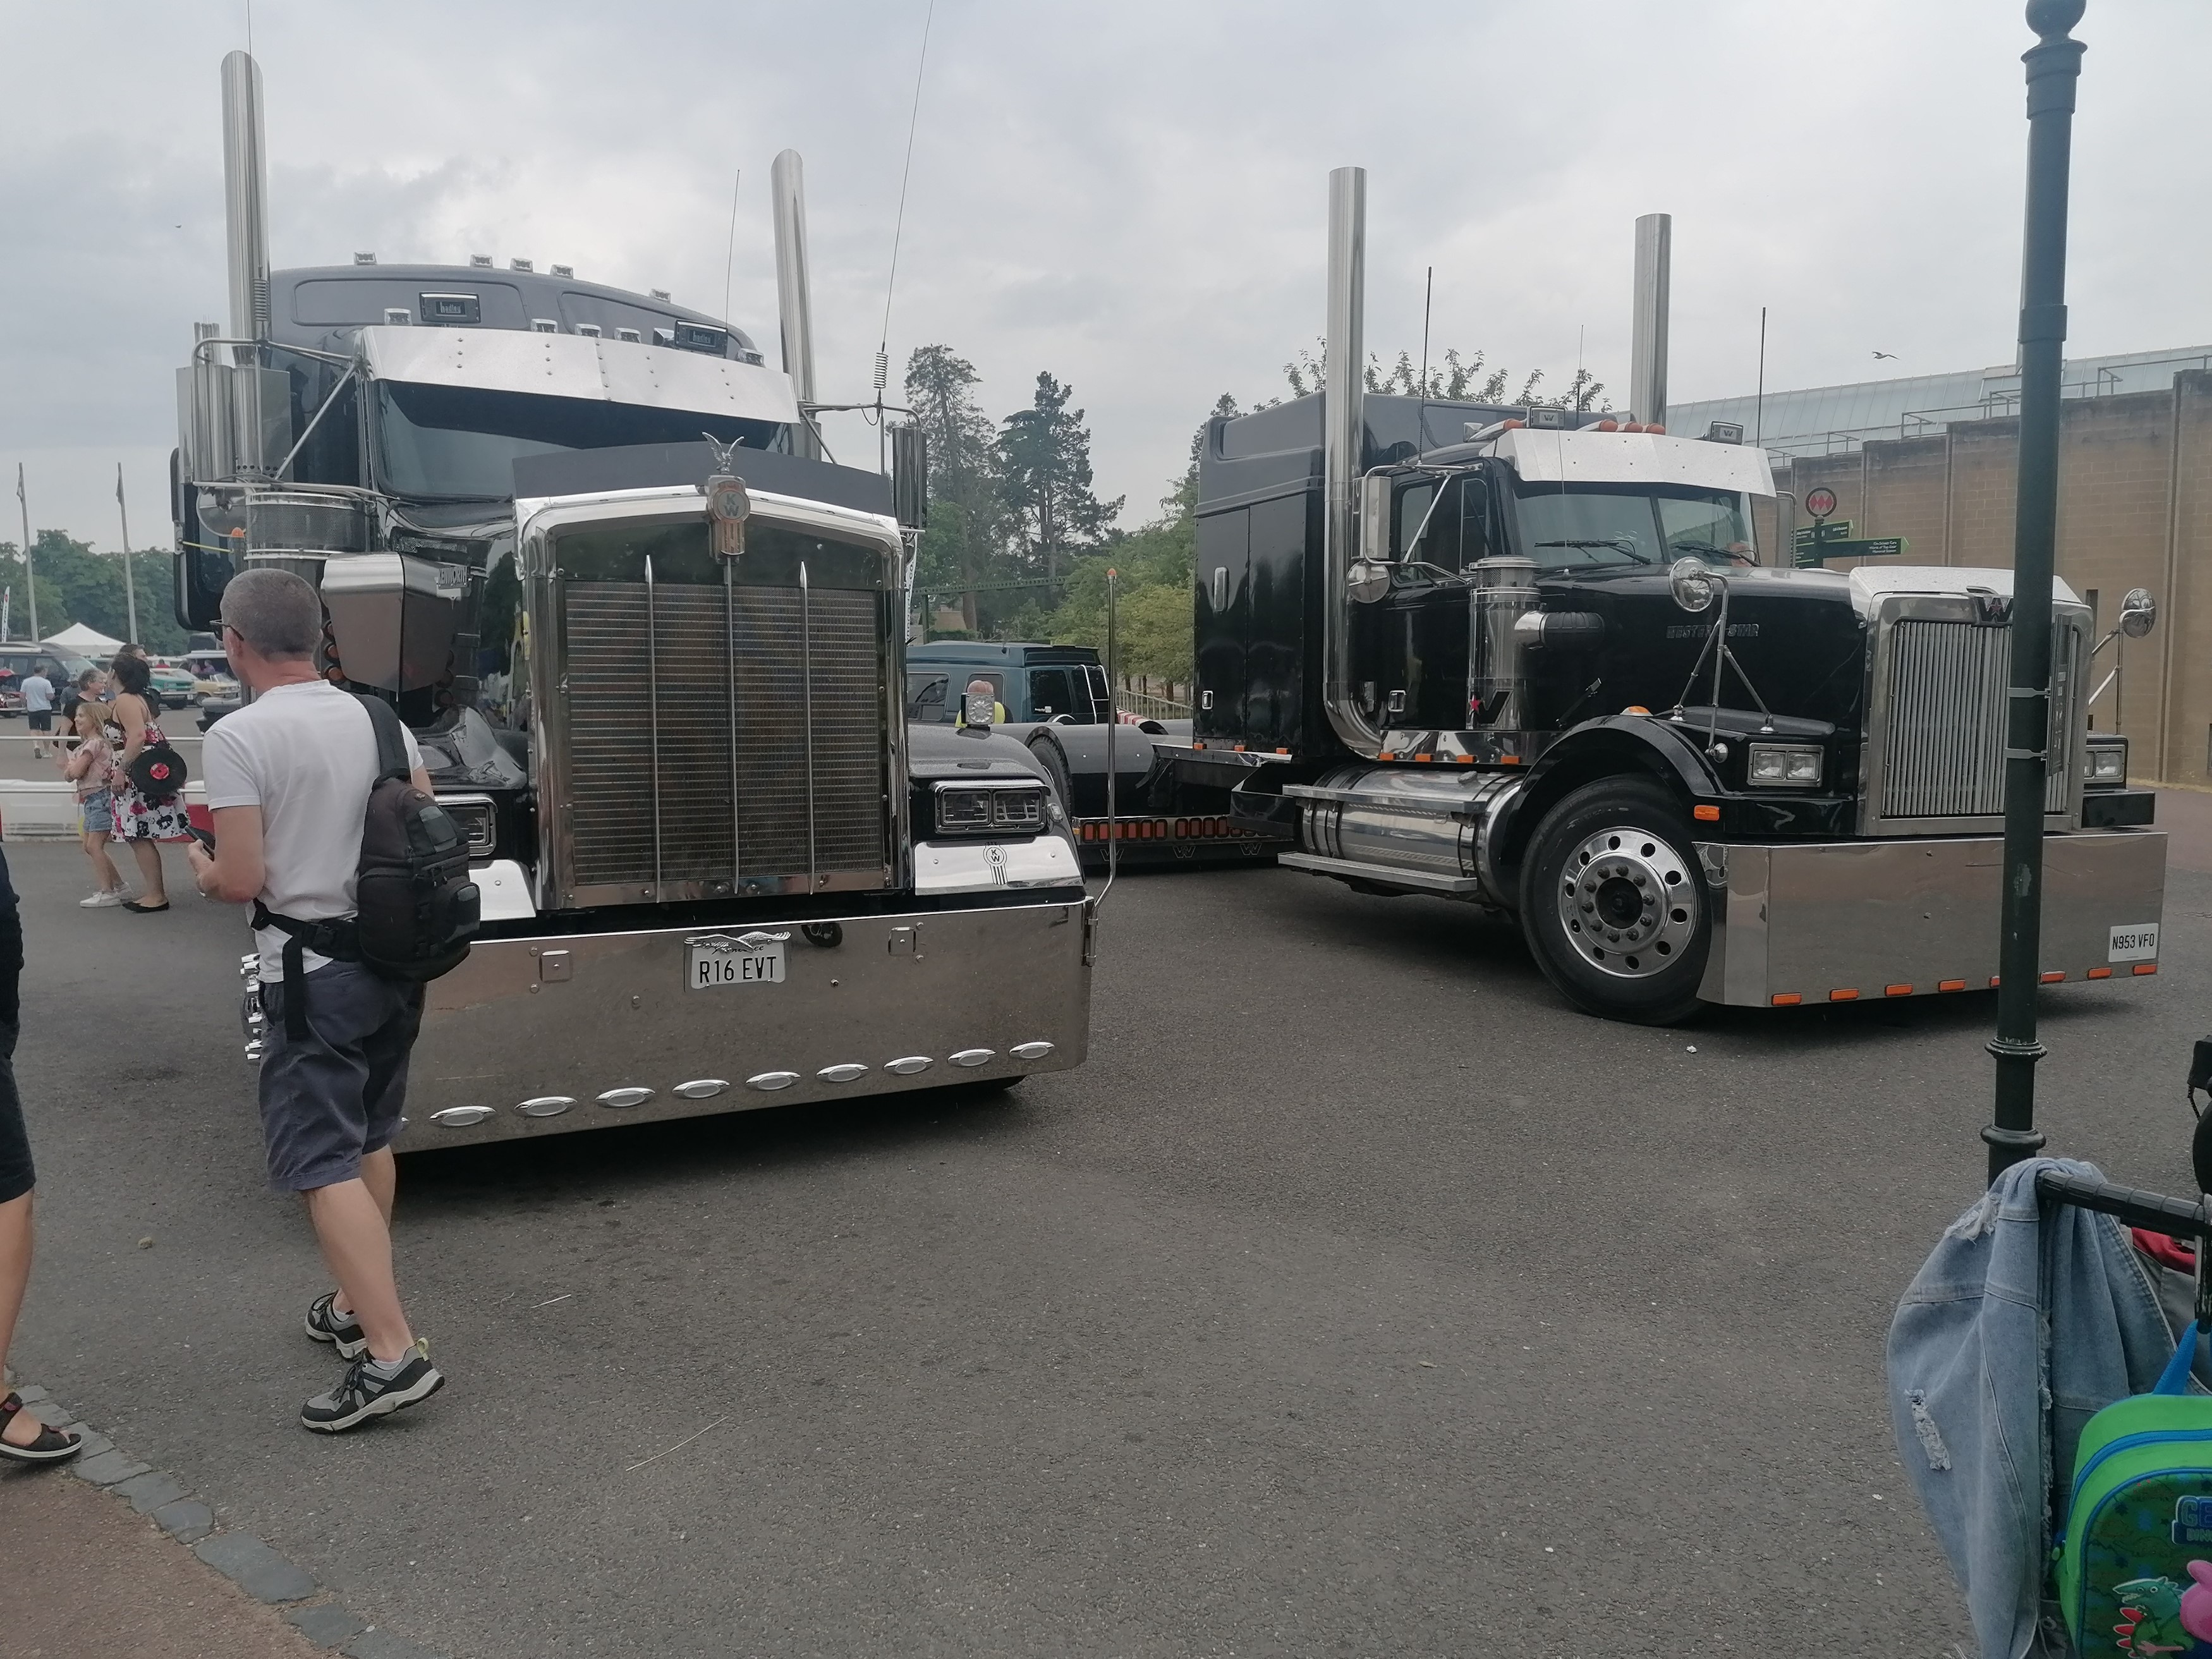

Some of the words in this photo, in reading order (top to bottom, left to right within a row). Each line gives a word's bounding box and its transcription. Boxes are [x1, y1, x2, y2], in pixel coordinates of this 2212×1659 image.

[439, 567, 468, 584] KENWORTH
[1666, 625, 1718, 639] WESTER
[2112, 935, 2136, 950] N953
[2139, 933, 2154, 948] VFO
[700, 959, 734, 983] R16
[743, 956, 777, 980] EVT
